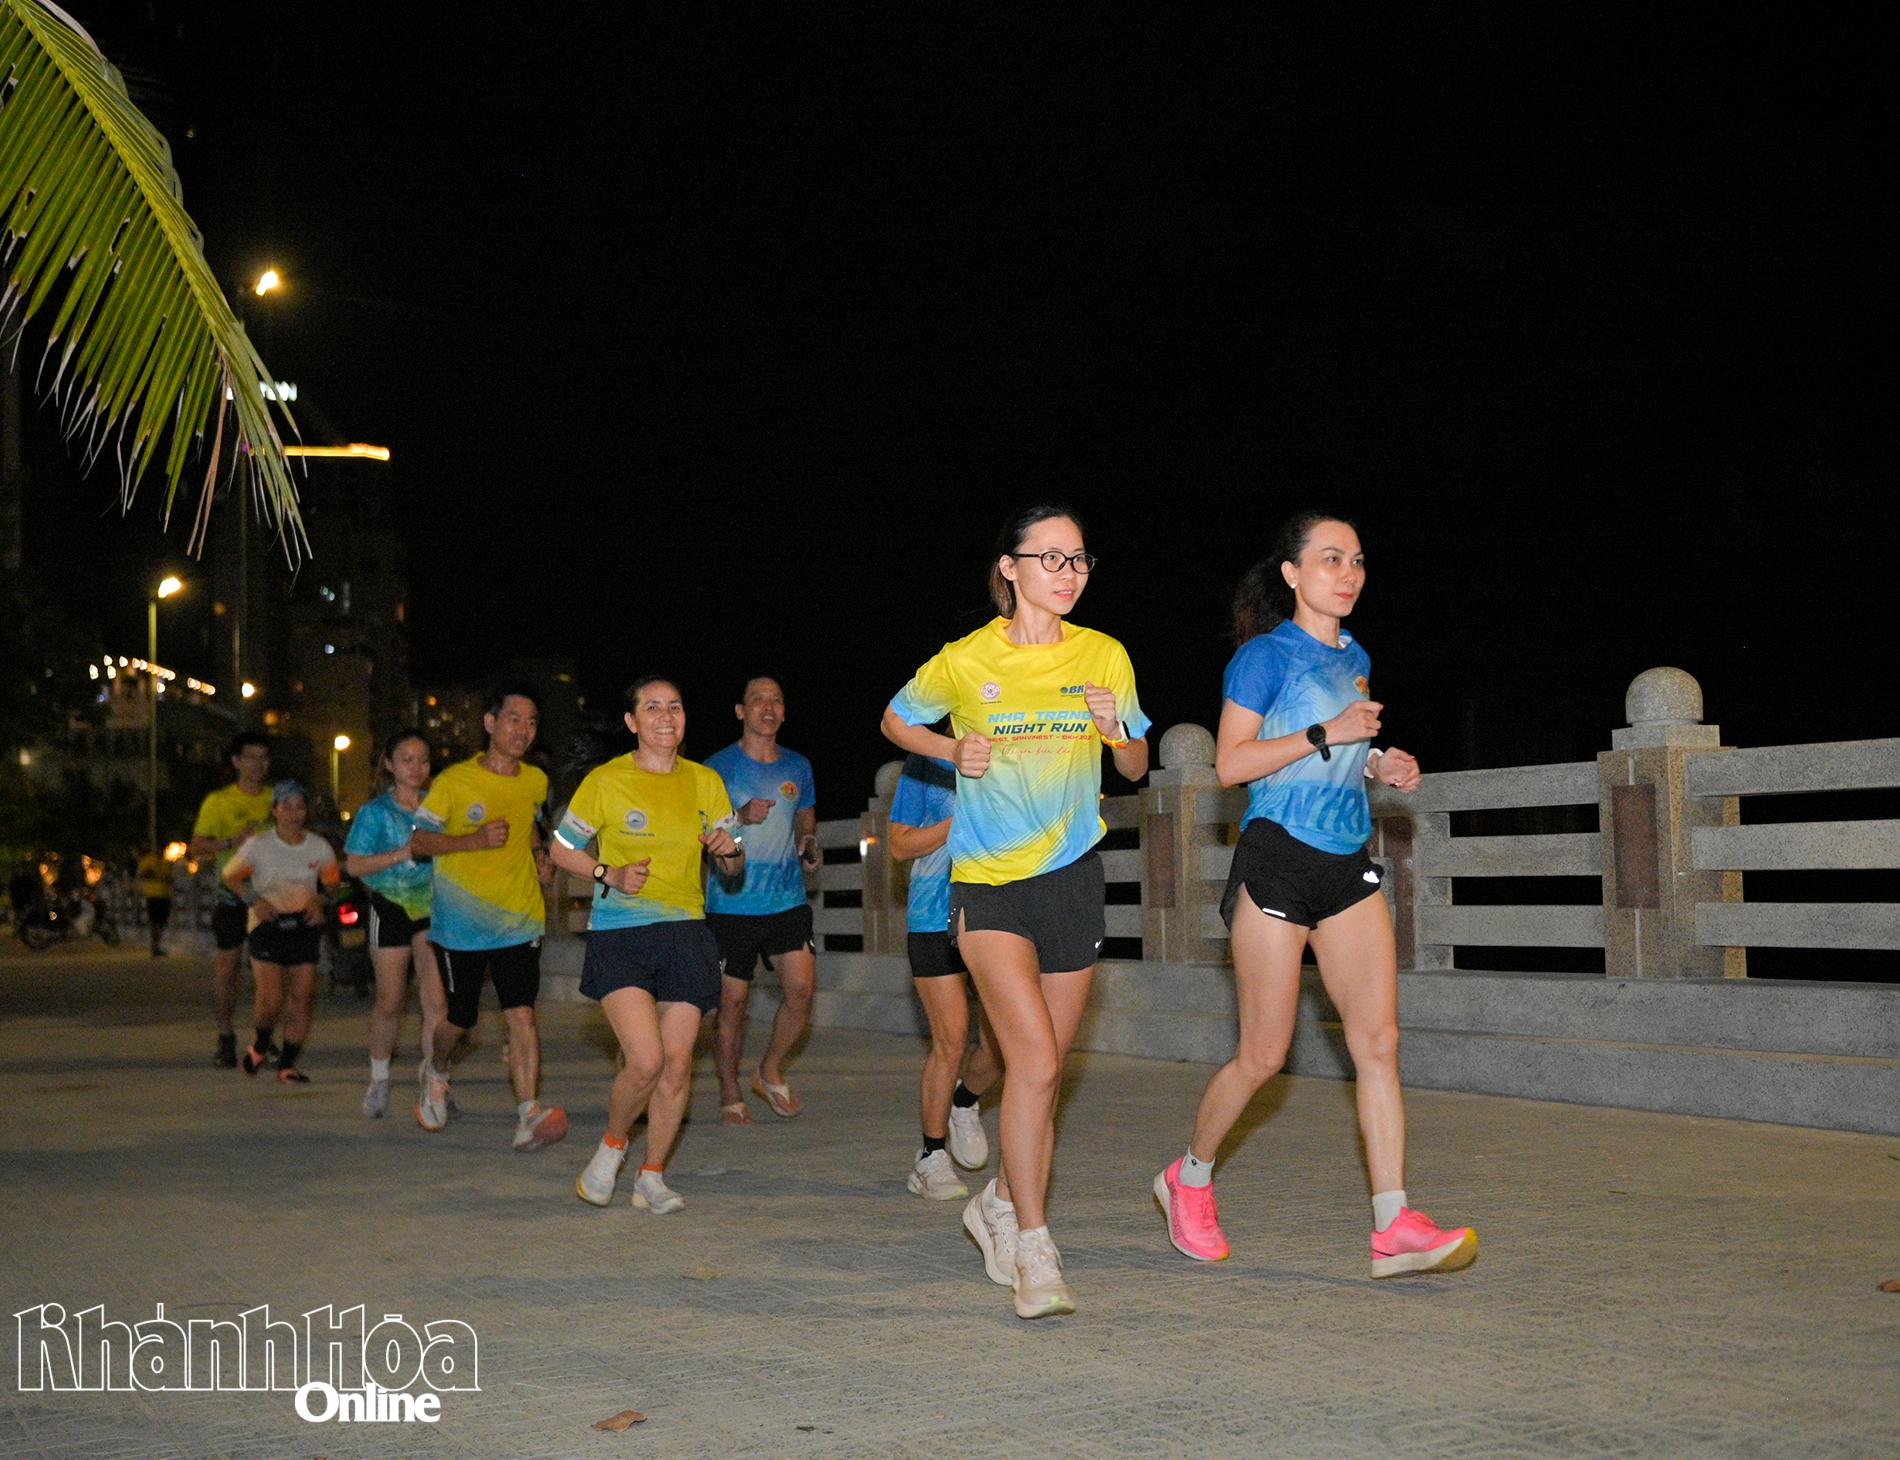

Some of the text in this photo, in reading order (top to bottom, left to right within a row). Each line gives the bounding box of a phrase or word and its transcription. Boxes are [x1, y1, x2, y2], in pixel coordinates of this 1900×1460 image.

[988, 711, 1092, 723] NHA TRANG
[993, 723, 1088, 735] NIGHT RUN
